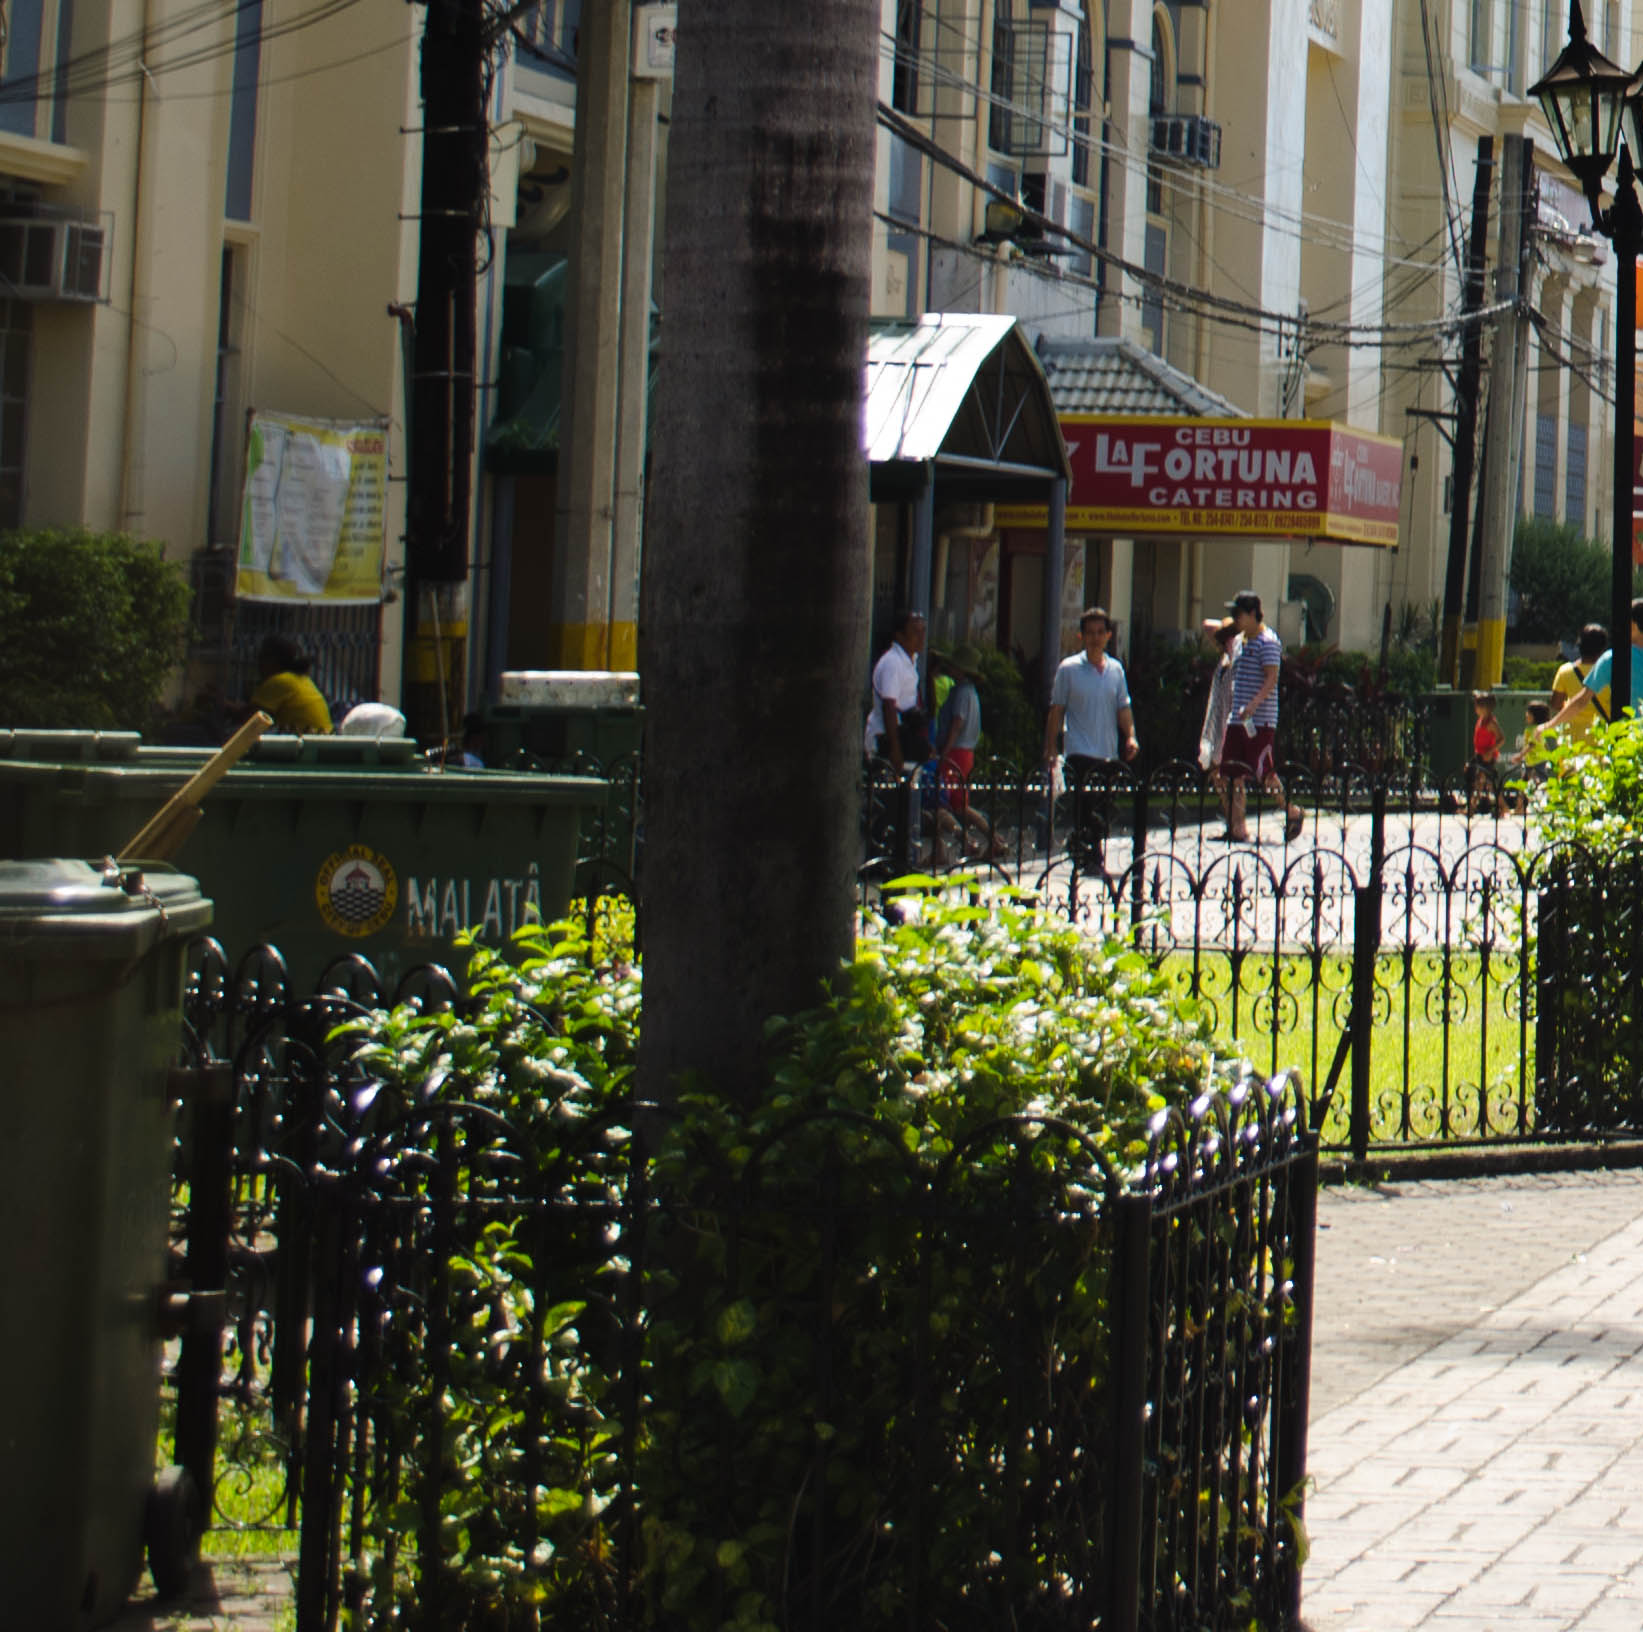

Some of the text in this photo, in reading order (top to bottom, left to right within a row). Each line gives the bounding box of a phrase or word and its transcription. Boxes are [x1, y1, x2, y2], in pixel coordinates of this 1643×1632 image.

[1175, 427, 1251, 447] CEBU
[1130, 442, 1318, 487] FORTUNA
[1149, 487, 1318, 509] CATERING
